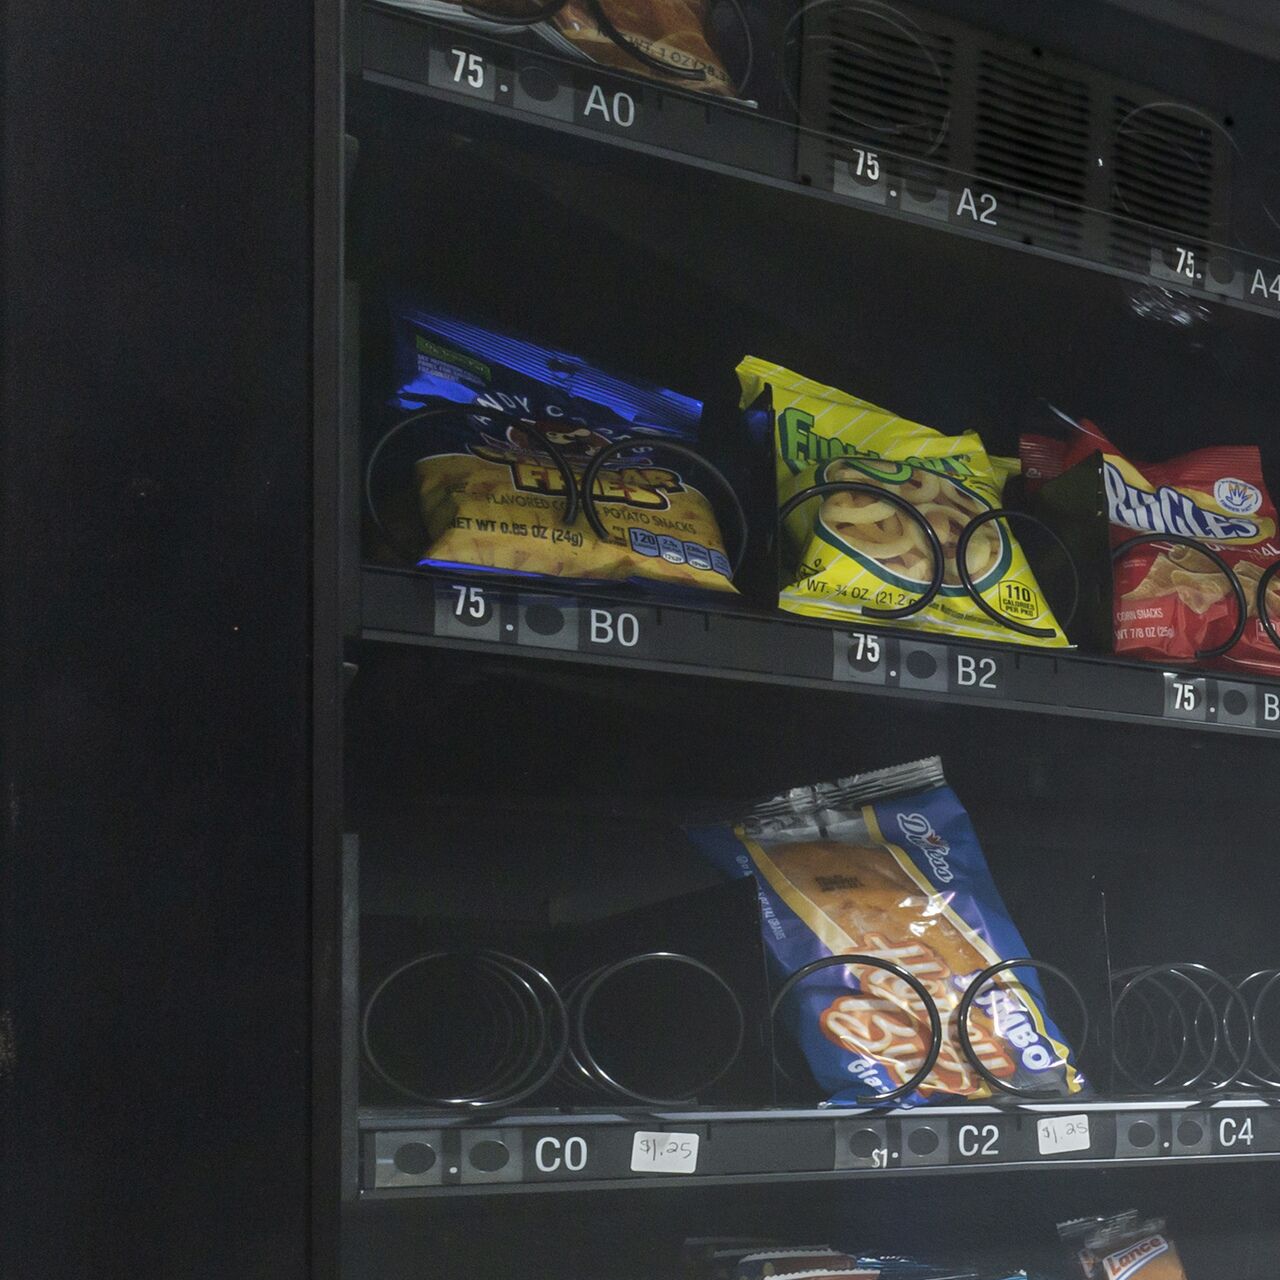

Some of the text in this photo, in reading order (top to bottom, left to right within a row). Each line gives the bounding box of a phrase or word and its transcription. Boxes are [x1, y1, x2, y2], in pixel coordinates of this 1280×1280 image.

[584, 85, 635, 128] A0
[957, 189, 998, 226] A2
[1005, 584, 1031, 603] 110
[591, 609, 639, 647] B0
[956, 657, 997, 691] B2
[958, 1125, 1000, 1157] C2
[1219, 1117, 1254, 1147] C4
[535, 1137, 588, 1172] C0
[1108, 1236, 1166, 1277] Lance
